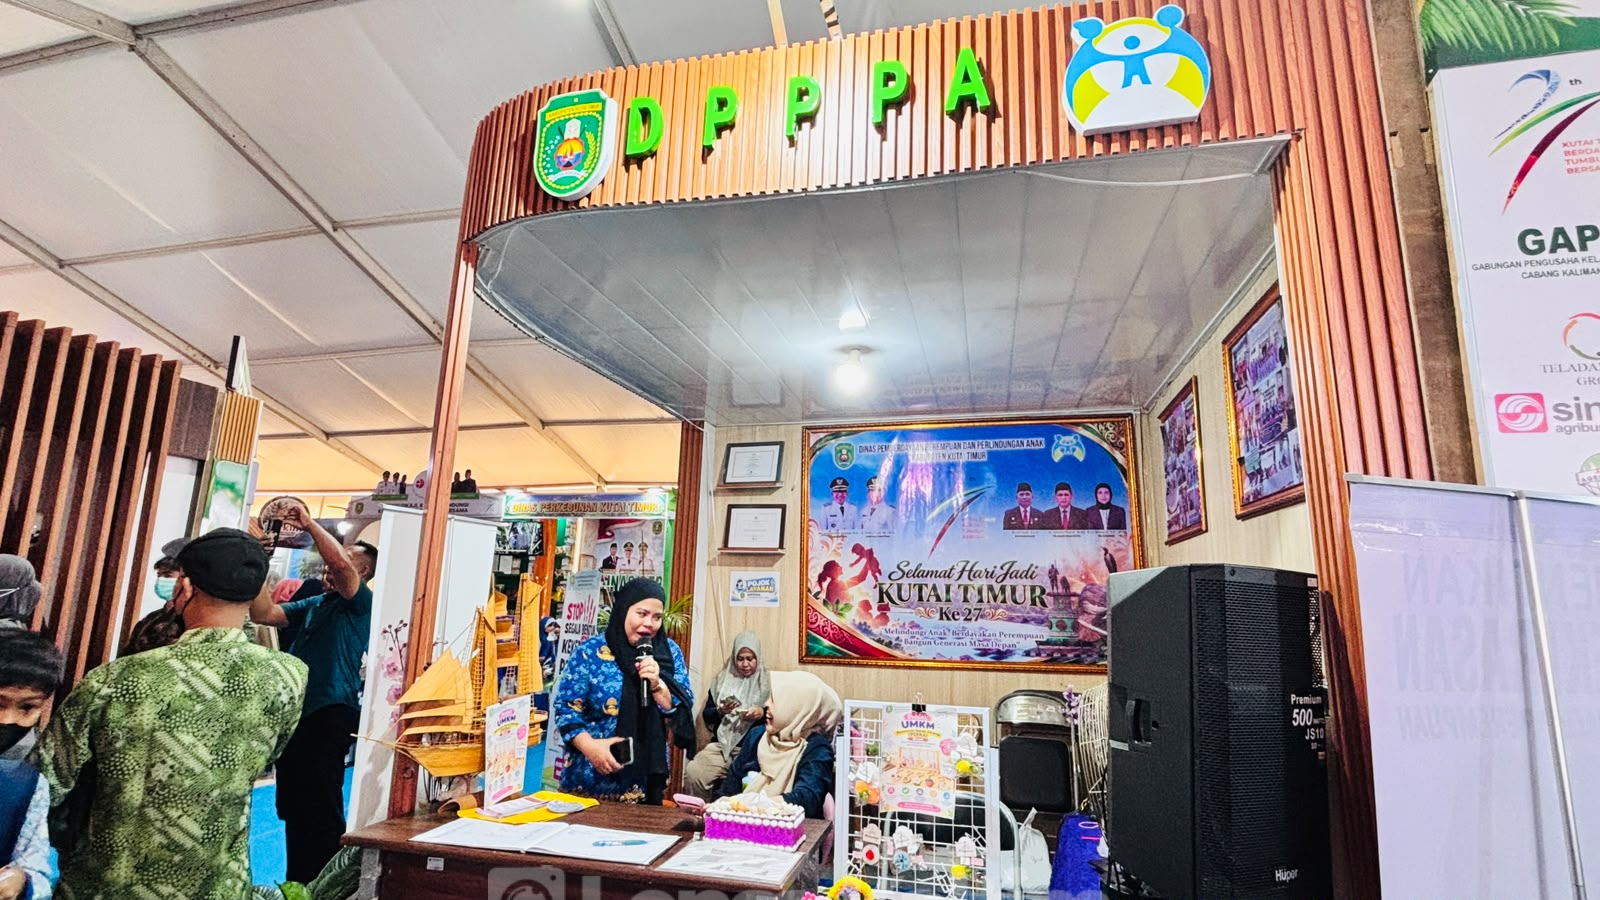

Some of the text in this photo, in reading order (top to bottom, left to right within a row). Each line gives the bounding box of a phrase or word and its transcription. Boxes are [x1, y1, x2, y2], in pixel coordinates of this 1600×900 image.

[1472, 260, 1521, 271] GABUNGAN
[1524, 257, 1579, 268] PENGUSAHA
[1521, 270, 1559, 279] CABANG
[963, 441, 976, 450] DAN
[977, 440, 1024, 450] PERLINDUNGAN
[1026, 439, 1044, 448] ANAK
[967, 451, 986, 460] TIMUR
[540, 502, 597, 513] PERKEBUNAN
[600, 502, 625, 513] KUTAI
[628, 502, 658, 513] TIMUR
[888, 560, 1039, 583] Selamat Hari Jadi
[877, 582, 1049, 608] KUTAI TIMUR
[566, 602, 584, 620] STOP
[938, 607, 982, 622] Ke 27
[952, 630, 997, 638] Berdayakan
[999, 631, 1045, 640] Perempuan
[1290, 693, 1322, 705] Premium
[1292, 708, 1313, 726] 500
[901, 720, 935, 730] UMKM
[1305, 728, 1324, 740] JS10
